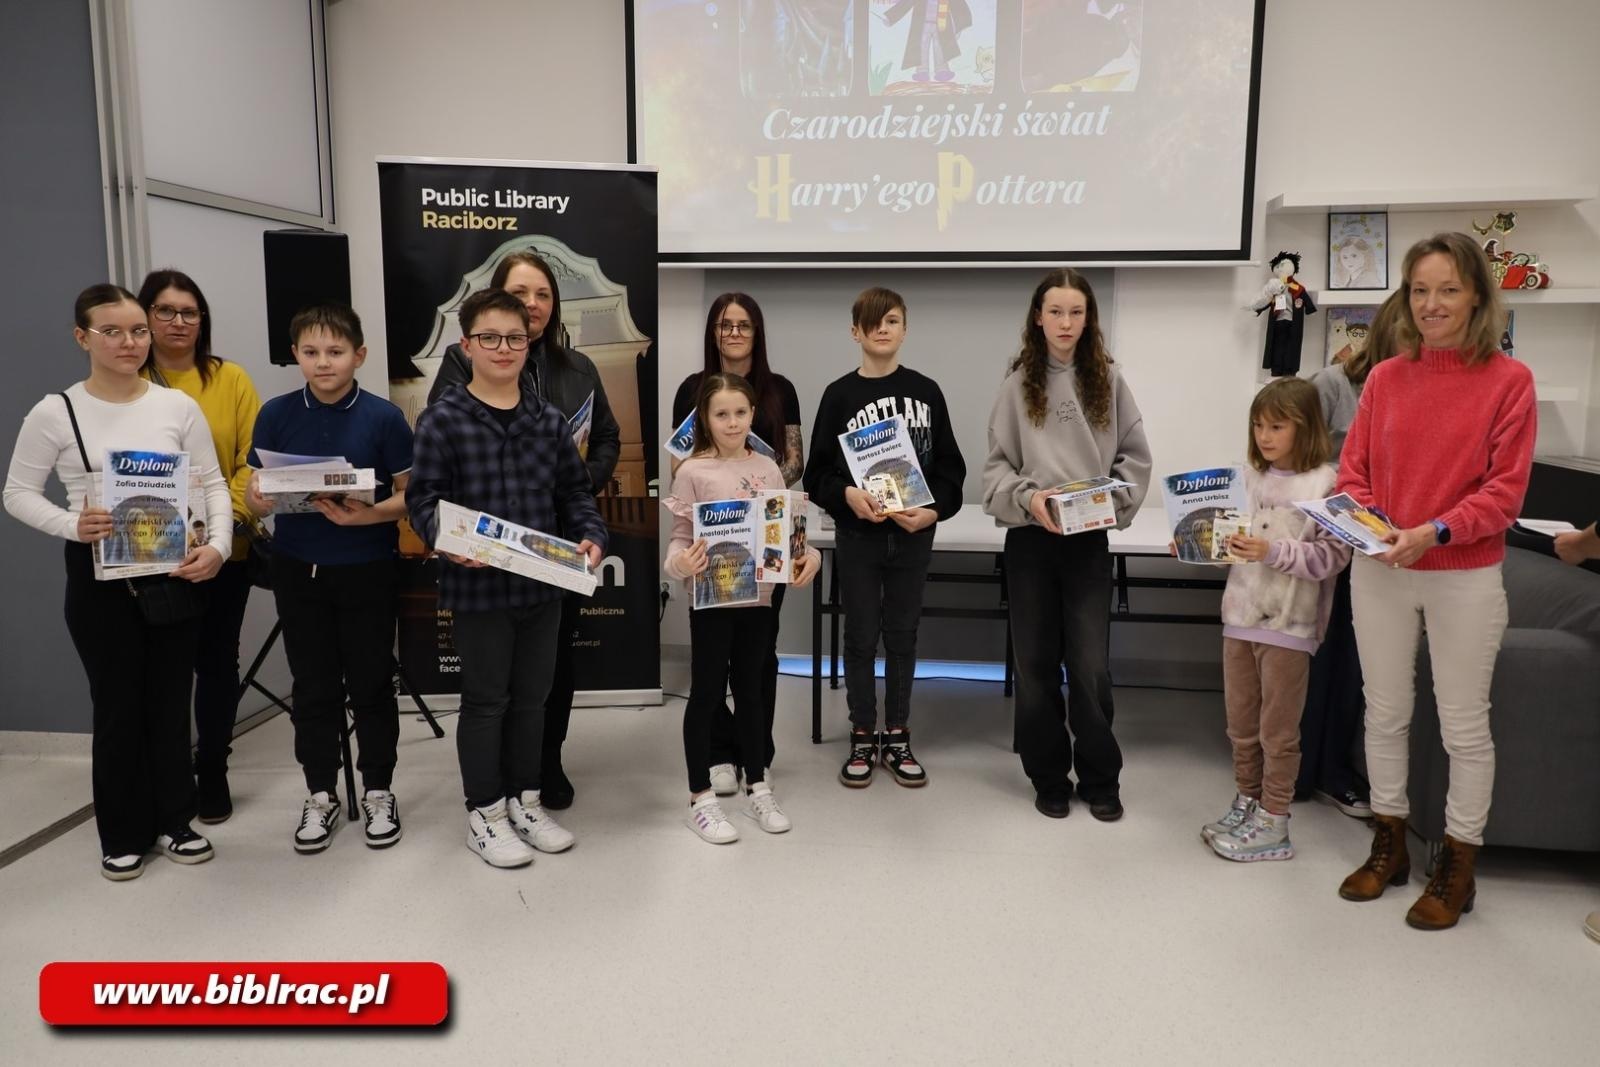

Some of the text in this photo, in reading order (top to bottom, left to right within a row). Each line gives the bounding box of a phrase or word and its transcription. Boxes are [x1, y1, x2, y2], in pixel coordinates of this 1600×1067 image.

[762, 100, 1112, 145] Czarodziejski świat
[421, 187, 570, 214] Public Library
[422, 210, 518, 231] Raciborz
[853, 426, 896, 449] Dyplom
[119, 457, 174, 473] Dyplom
[115, 480, 177, 489] Zofia Dziudziek
[1176, 475, 1230, 493] Dyplom
[1182, 493, 1230, 506] Anna Urbisz
[704, 506, 746, 523] Dyplom
[699, 526, 752, 539] Anastazja Świerc
[580, 607, 625, 616] Publiczna
[439, 664, 461, 673] face
